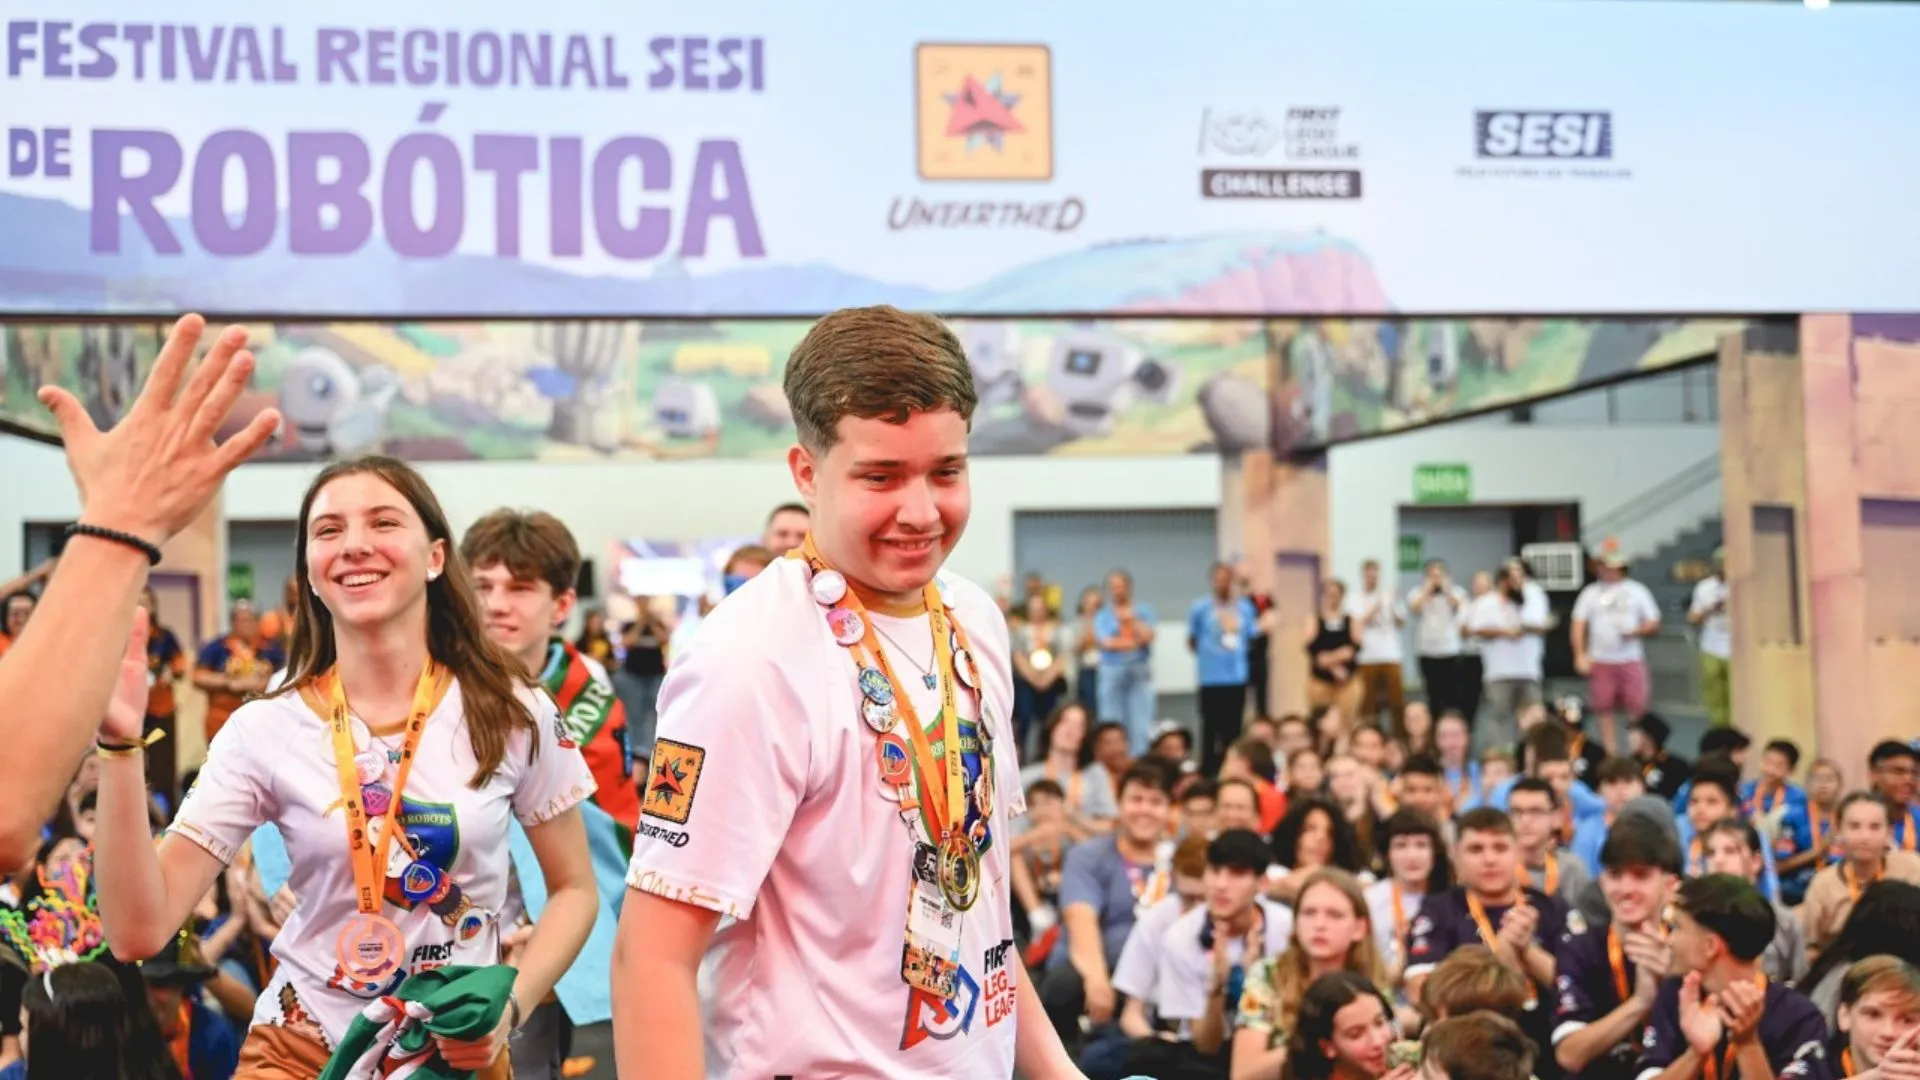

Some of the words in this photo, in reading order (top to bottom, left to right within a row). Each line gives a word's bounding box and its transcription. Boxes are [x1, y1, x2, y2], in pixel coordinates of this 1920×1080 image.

[7, 21, 298, 82] FESTIVAL
[316, 27, 629, 89] REGIONAL
[647, 36, 766, 91] SESI
[1484, 112, 1602, 157] SESI
[8, 127, 71, 178] DE
[90, 102, 767, 261] ROBÓTICA
[1209, 171, 1352, 196] CHALLENGE
[887, 195, 1085, 234] UNEARTHED
[636, 820, 690, 848] NEARTHED
[411, 939, 455, 963] FIRST
[983, 969, 1016, 1002] LEG
